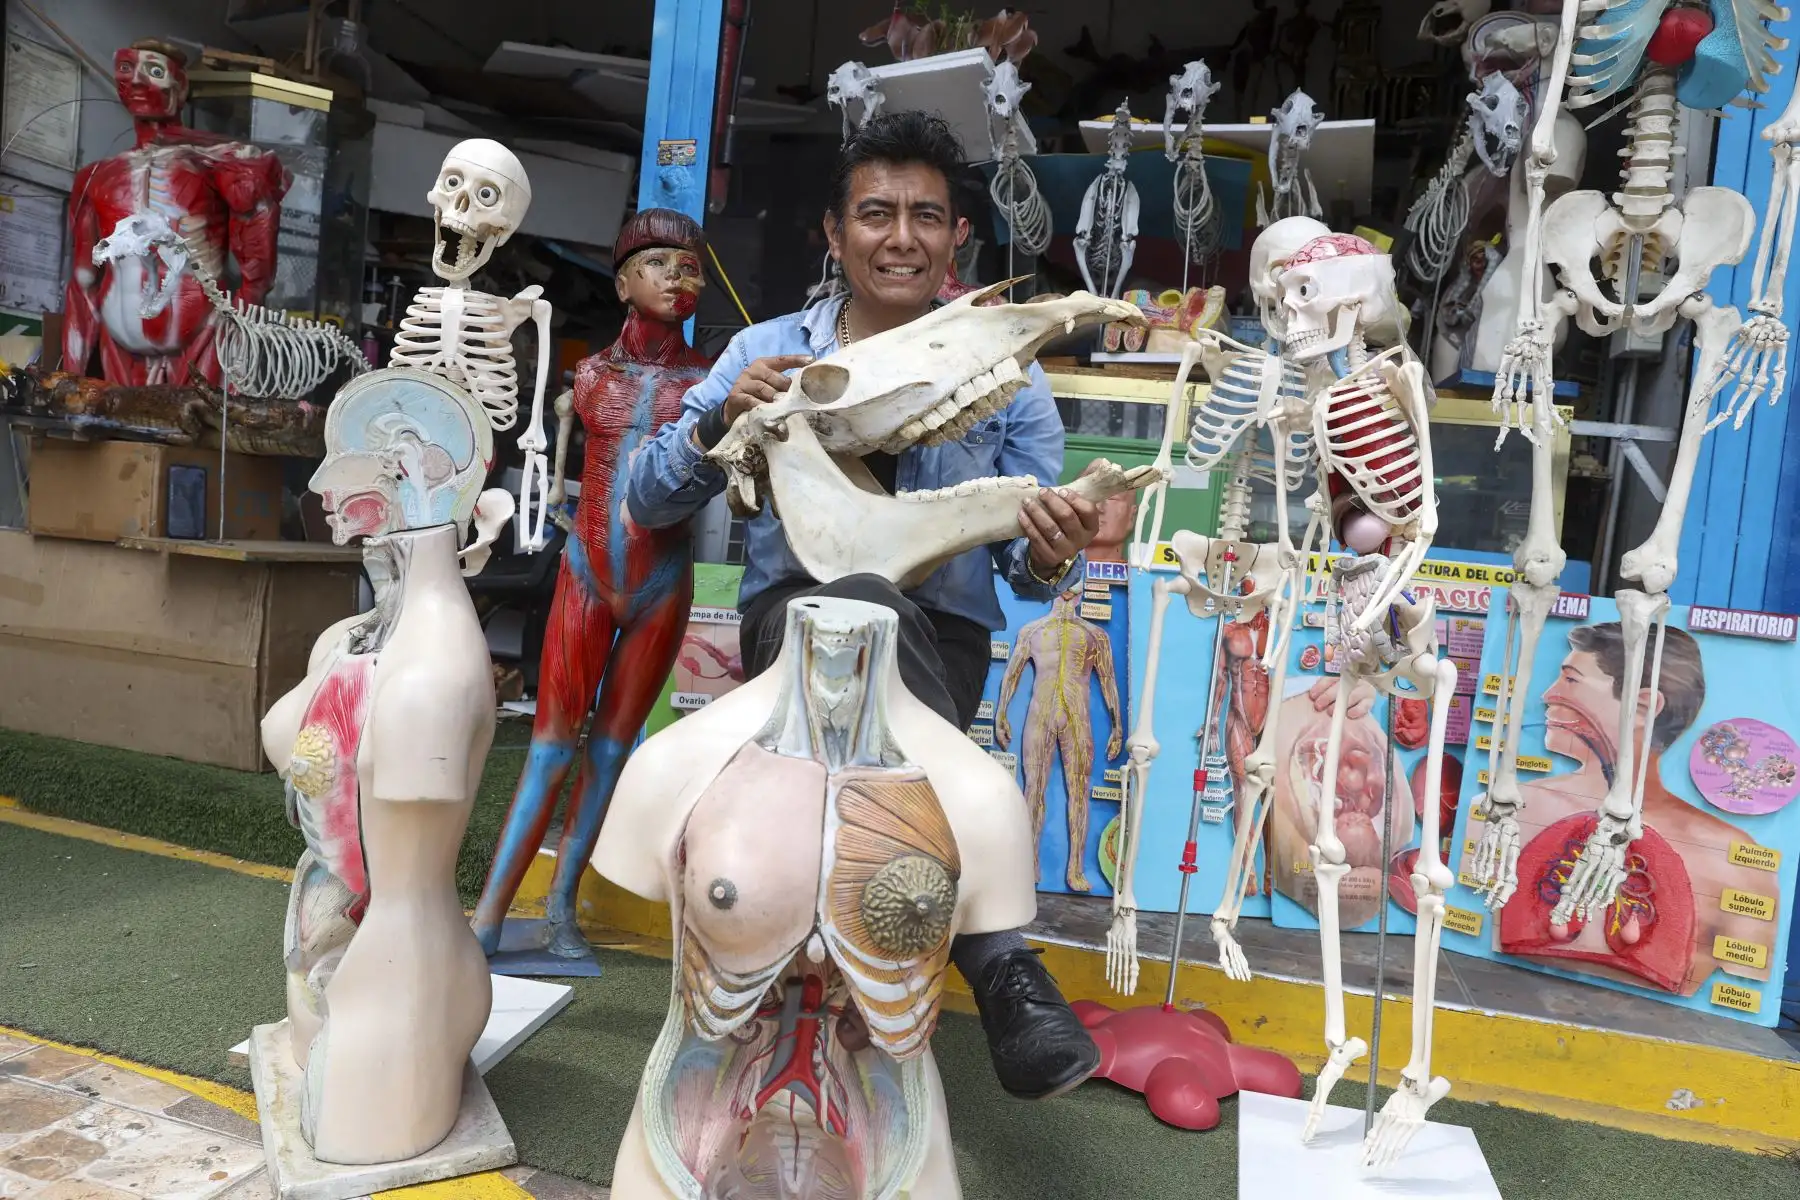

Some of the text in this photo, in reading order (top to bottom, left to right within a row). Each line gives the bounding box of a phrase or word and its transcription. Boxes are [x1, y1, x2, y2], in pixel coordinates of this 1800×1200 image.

[1088, 562, 1128, 579] NER
[1466, 568, 1489, 581] DEL
[1551, 595, 1588, 616] TEMA
[688, 611, 711, 620] ompa
[713, 611, 724, 619] de
[1690, 607, 1794, 638] RESPIRATORIO
[679, 696, 706, 705] Ovario
[1516, 759, 1548, 769] Epiglotis
[1739, 845, 1774, 859] Pulmón
[1734, 854, 1776, 869] izquierdo
[1733, 893, 1765, 907] Lóbulo
[1448, 909, 1476, 922] Pulmón
[1728, 902, 1767, 917] superior
[1445, 919, 1475, 932] derecho
[1726, 940, 1757, 954] Lóbulo
[1725, 951, 1754, 963] medio
[1720, 985, 1751, 999] Lóbulo
[1718, 995, 1752, 1009] inferior
